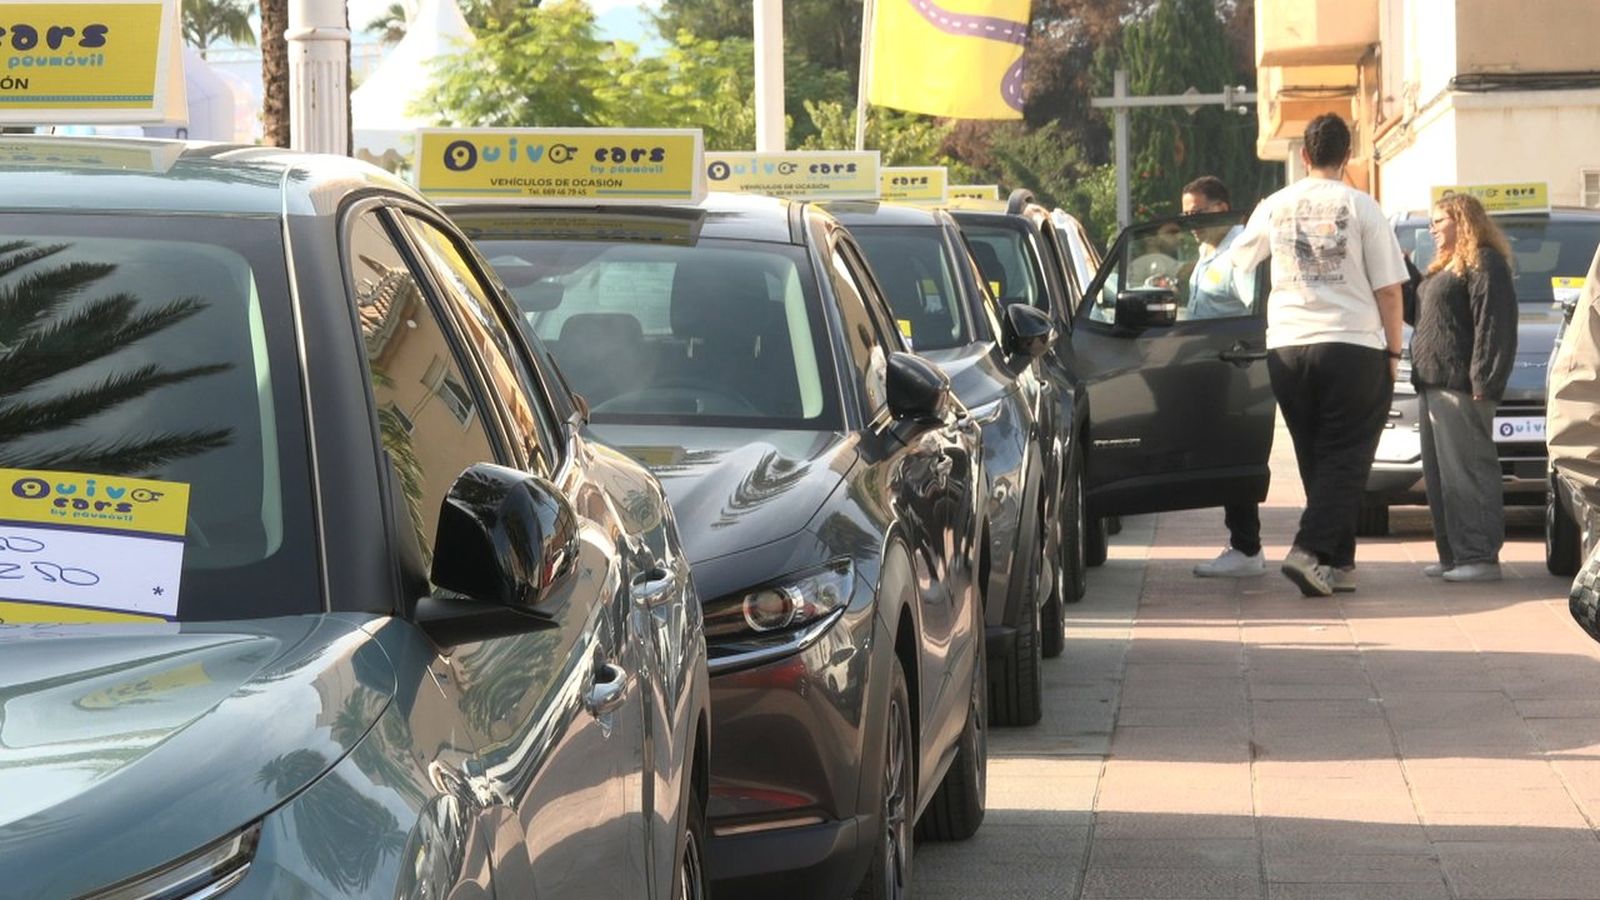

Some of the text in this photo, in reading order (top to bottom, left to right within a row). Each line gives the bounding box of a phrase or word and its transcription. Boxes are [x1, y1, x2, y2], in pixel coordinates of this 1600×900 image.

[0, 24, 109, 51] ars
[594, 146, 666, 164] cars
[809, 162, 857, 175] cars
[490, 177, 623, 188] VEHÍCULOS DE OCASIÓN
[1500, 421, 1546, 437] Quiv
[53, 497, 134, 513] cars
